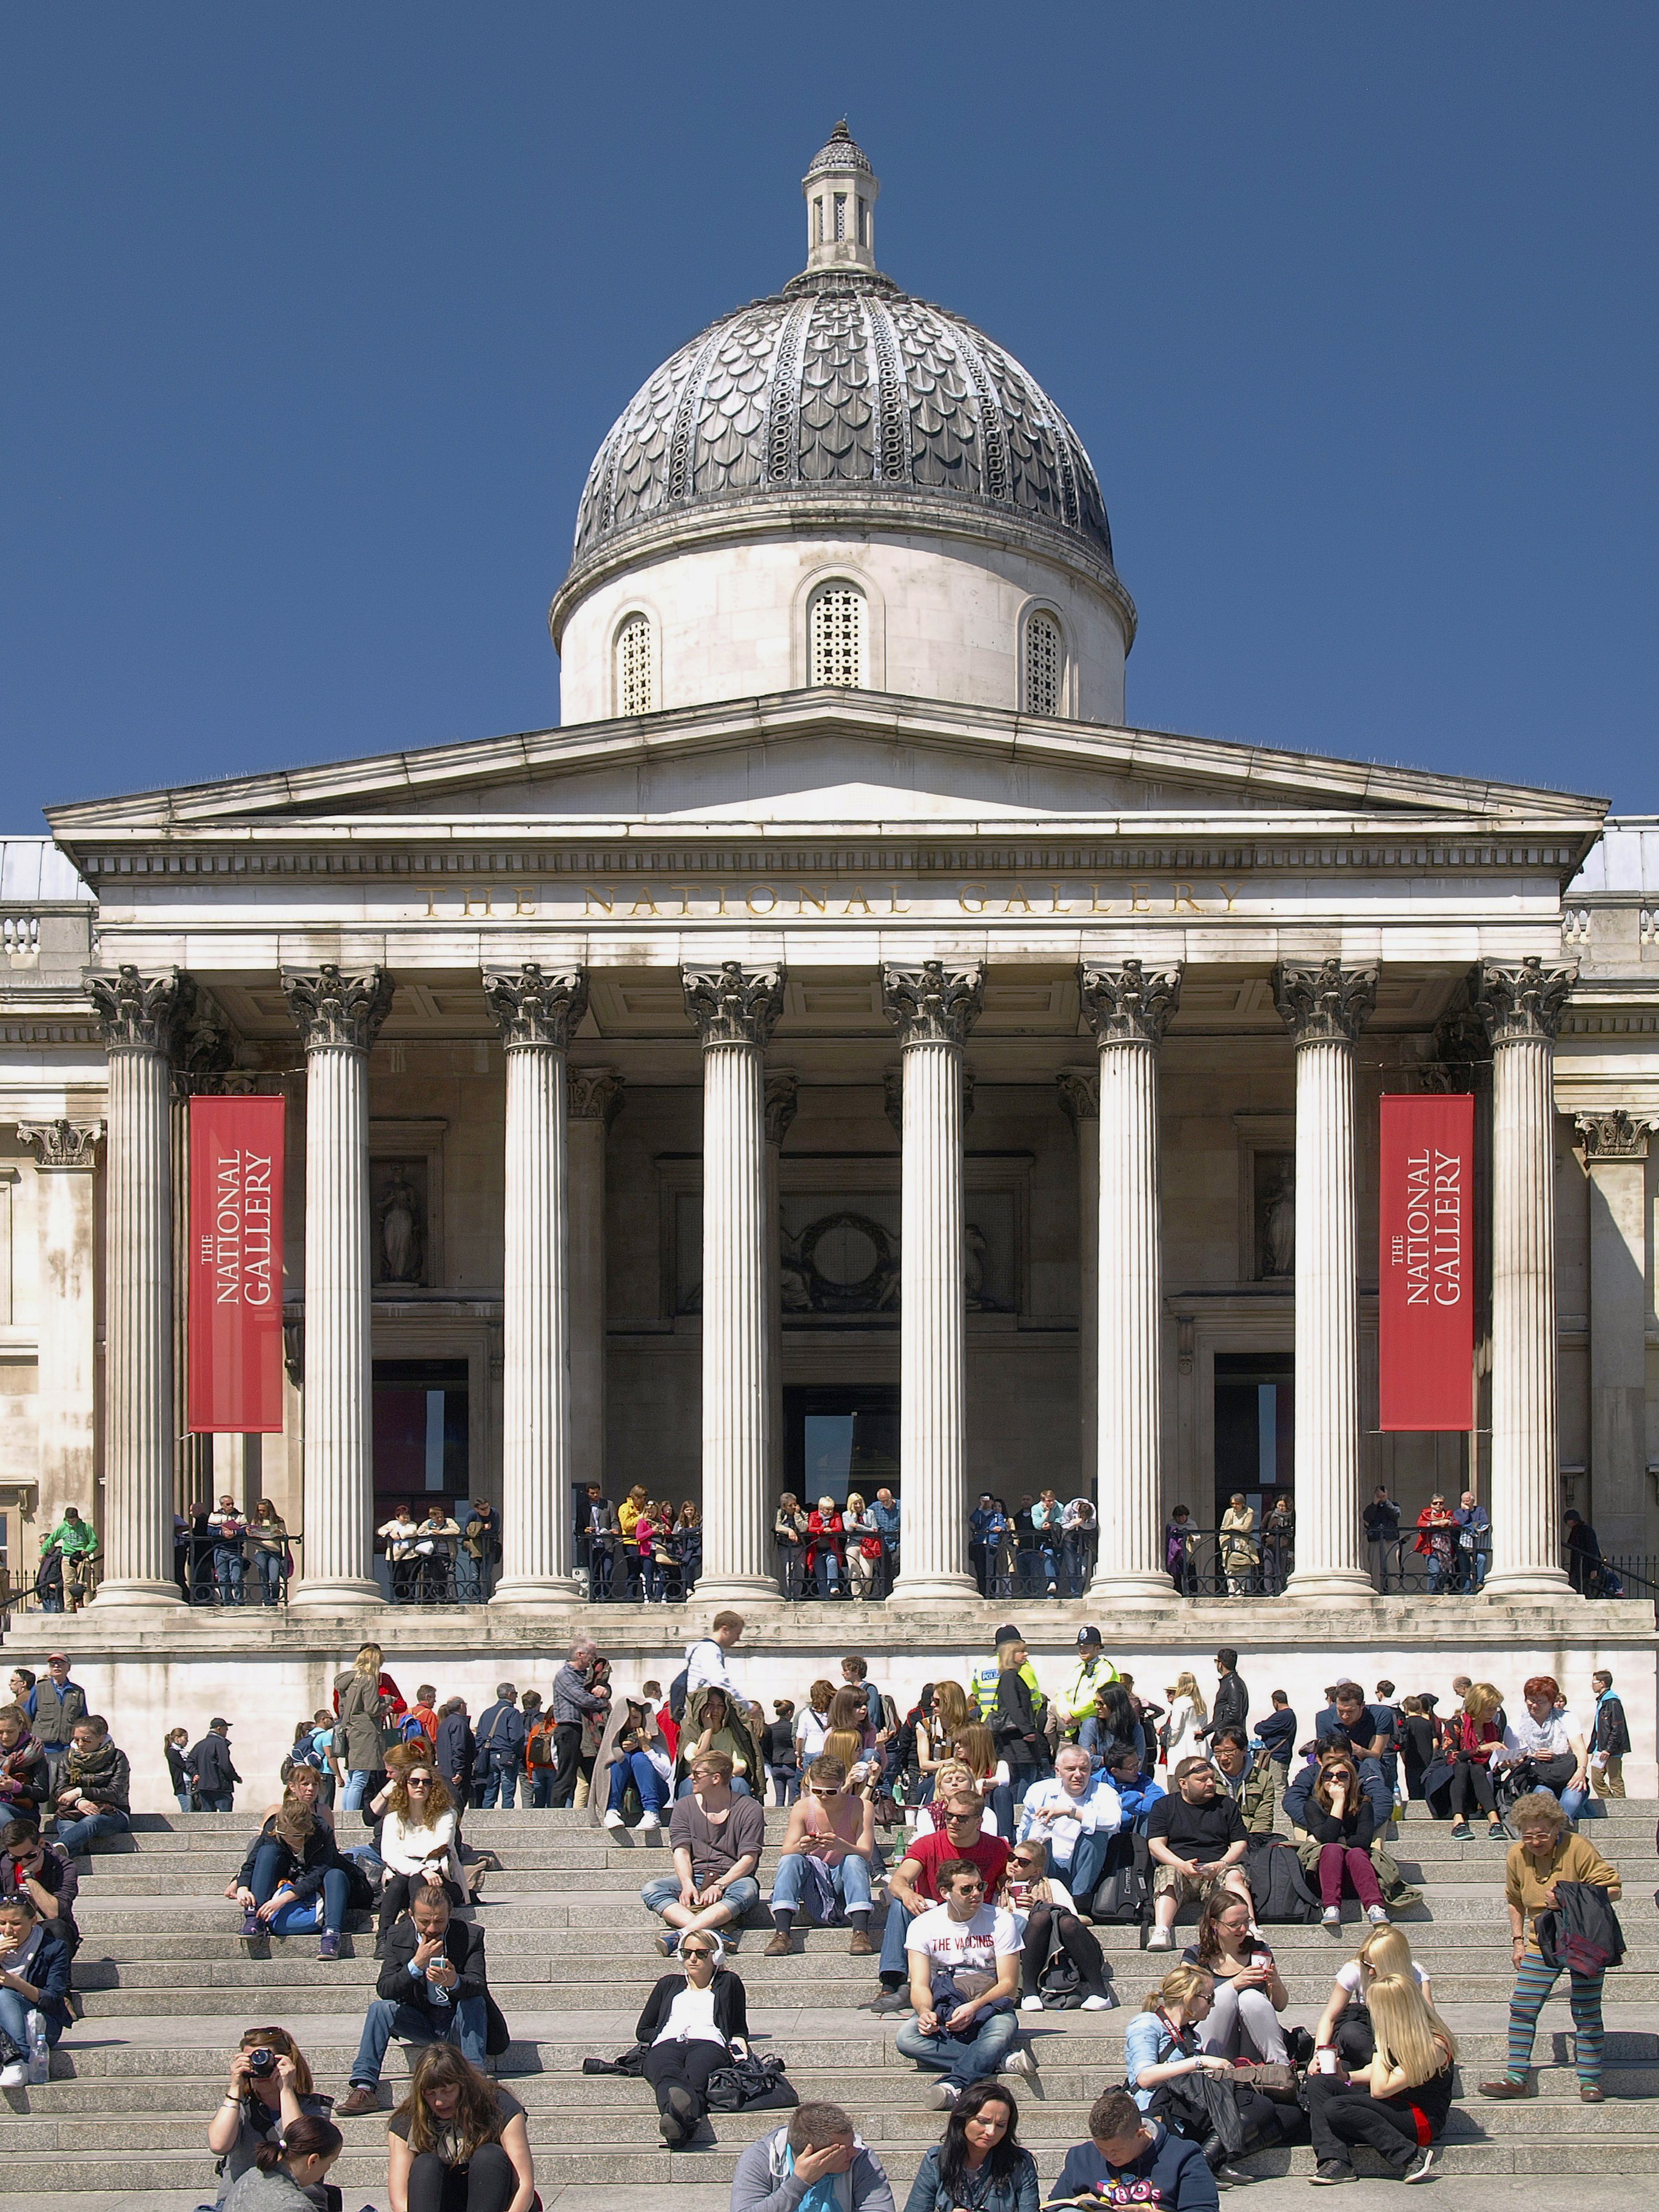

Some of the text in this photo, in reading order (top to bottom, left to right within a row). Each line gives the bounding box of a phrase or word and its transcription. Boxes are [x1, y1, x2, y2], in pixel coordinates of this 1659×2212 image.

[416, 883, 1244, 916] THE NATIONAL GALLERY
[201, 1235, 213, 1265] THE
[217, 1149, 240, 1304] NATIONAL
[244, 1149, 271, 1305] GALLERY
[1392, 1235, 1403, 1265] THE
[1407, 1148, 1429, 1305] NATIONAL
[1434, 1148, 1461, 1305] GALLERY
[932, 1937, 951, 1951] THE
